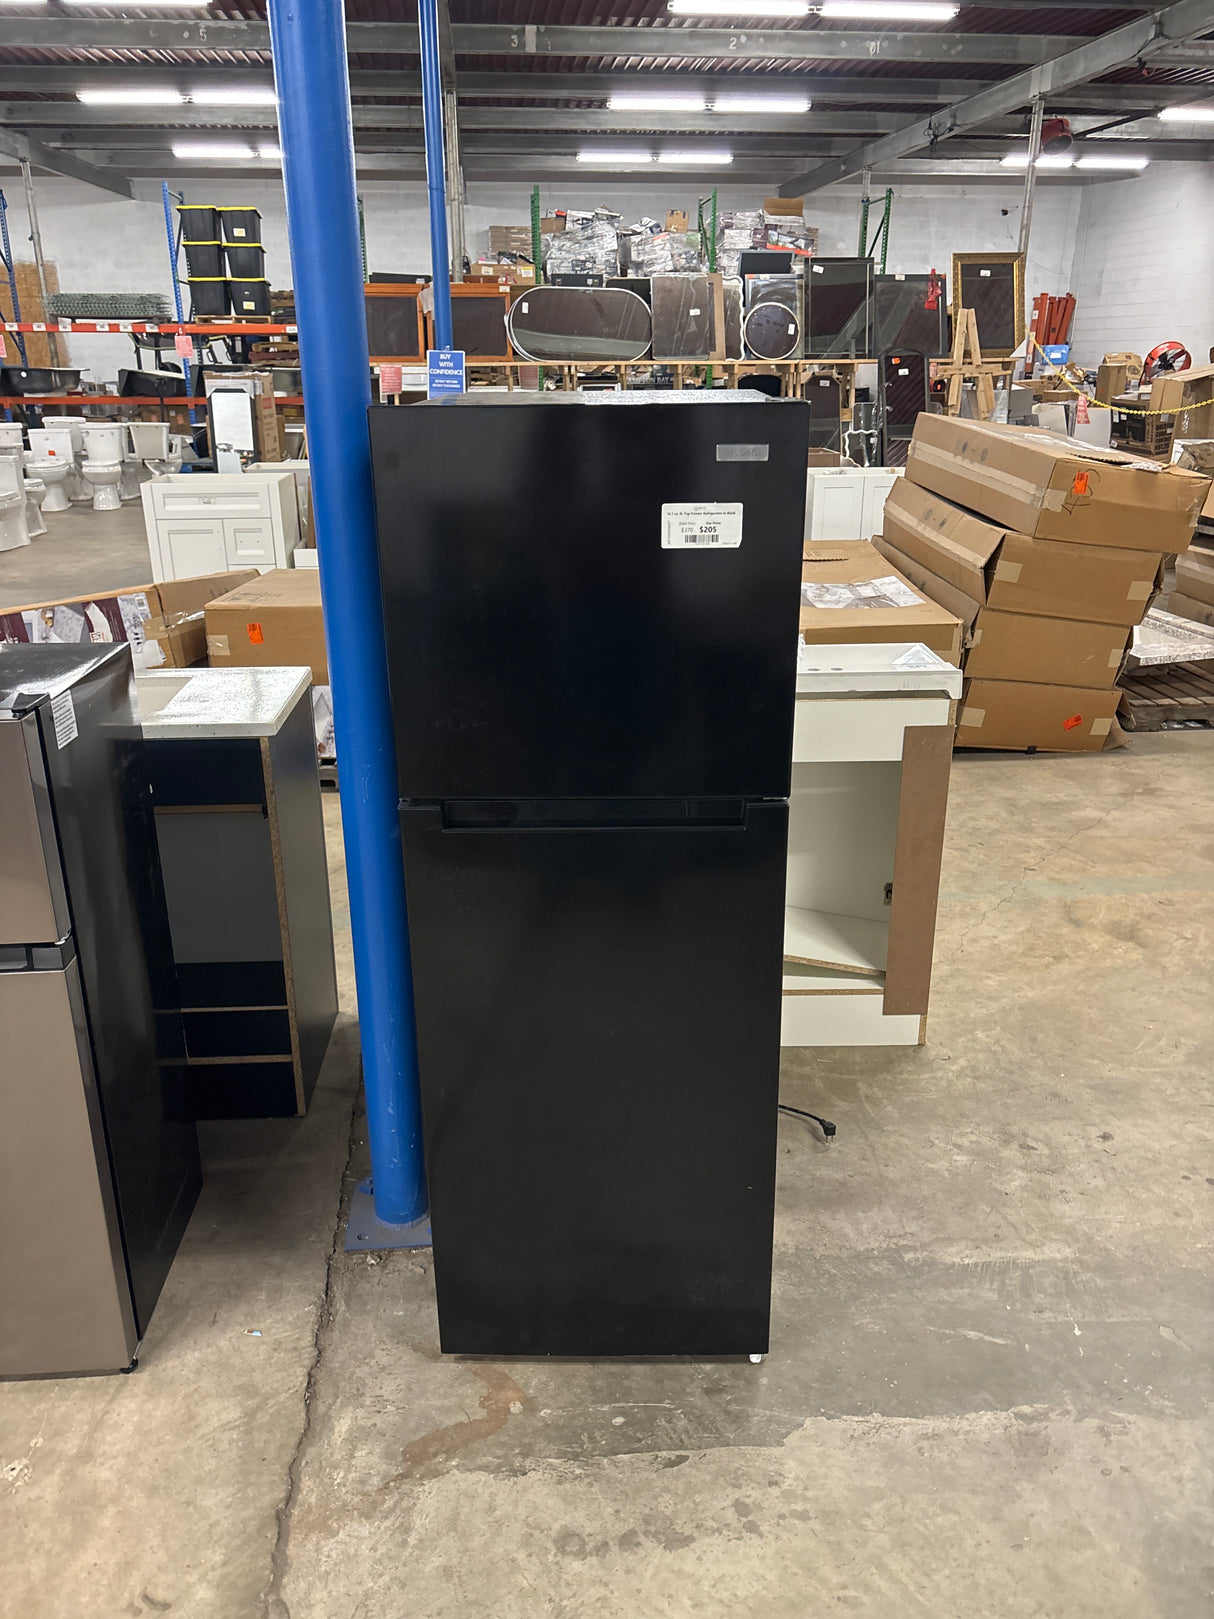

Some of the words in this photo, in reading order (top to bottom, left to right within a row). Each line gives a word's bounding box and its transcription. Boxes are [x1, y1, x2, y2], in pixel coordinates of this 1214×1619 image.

[199, 28, 207, 42] 5
[510, 34, 519, 48] 3
[728, 37, 737, 50] 2
[430, 368, 462, 376] CONFIDENCE
[656, 376, 670, 384] BAY
[699, 525, 717, 533] $205
